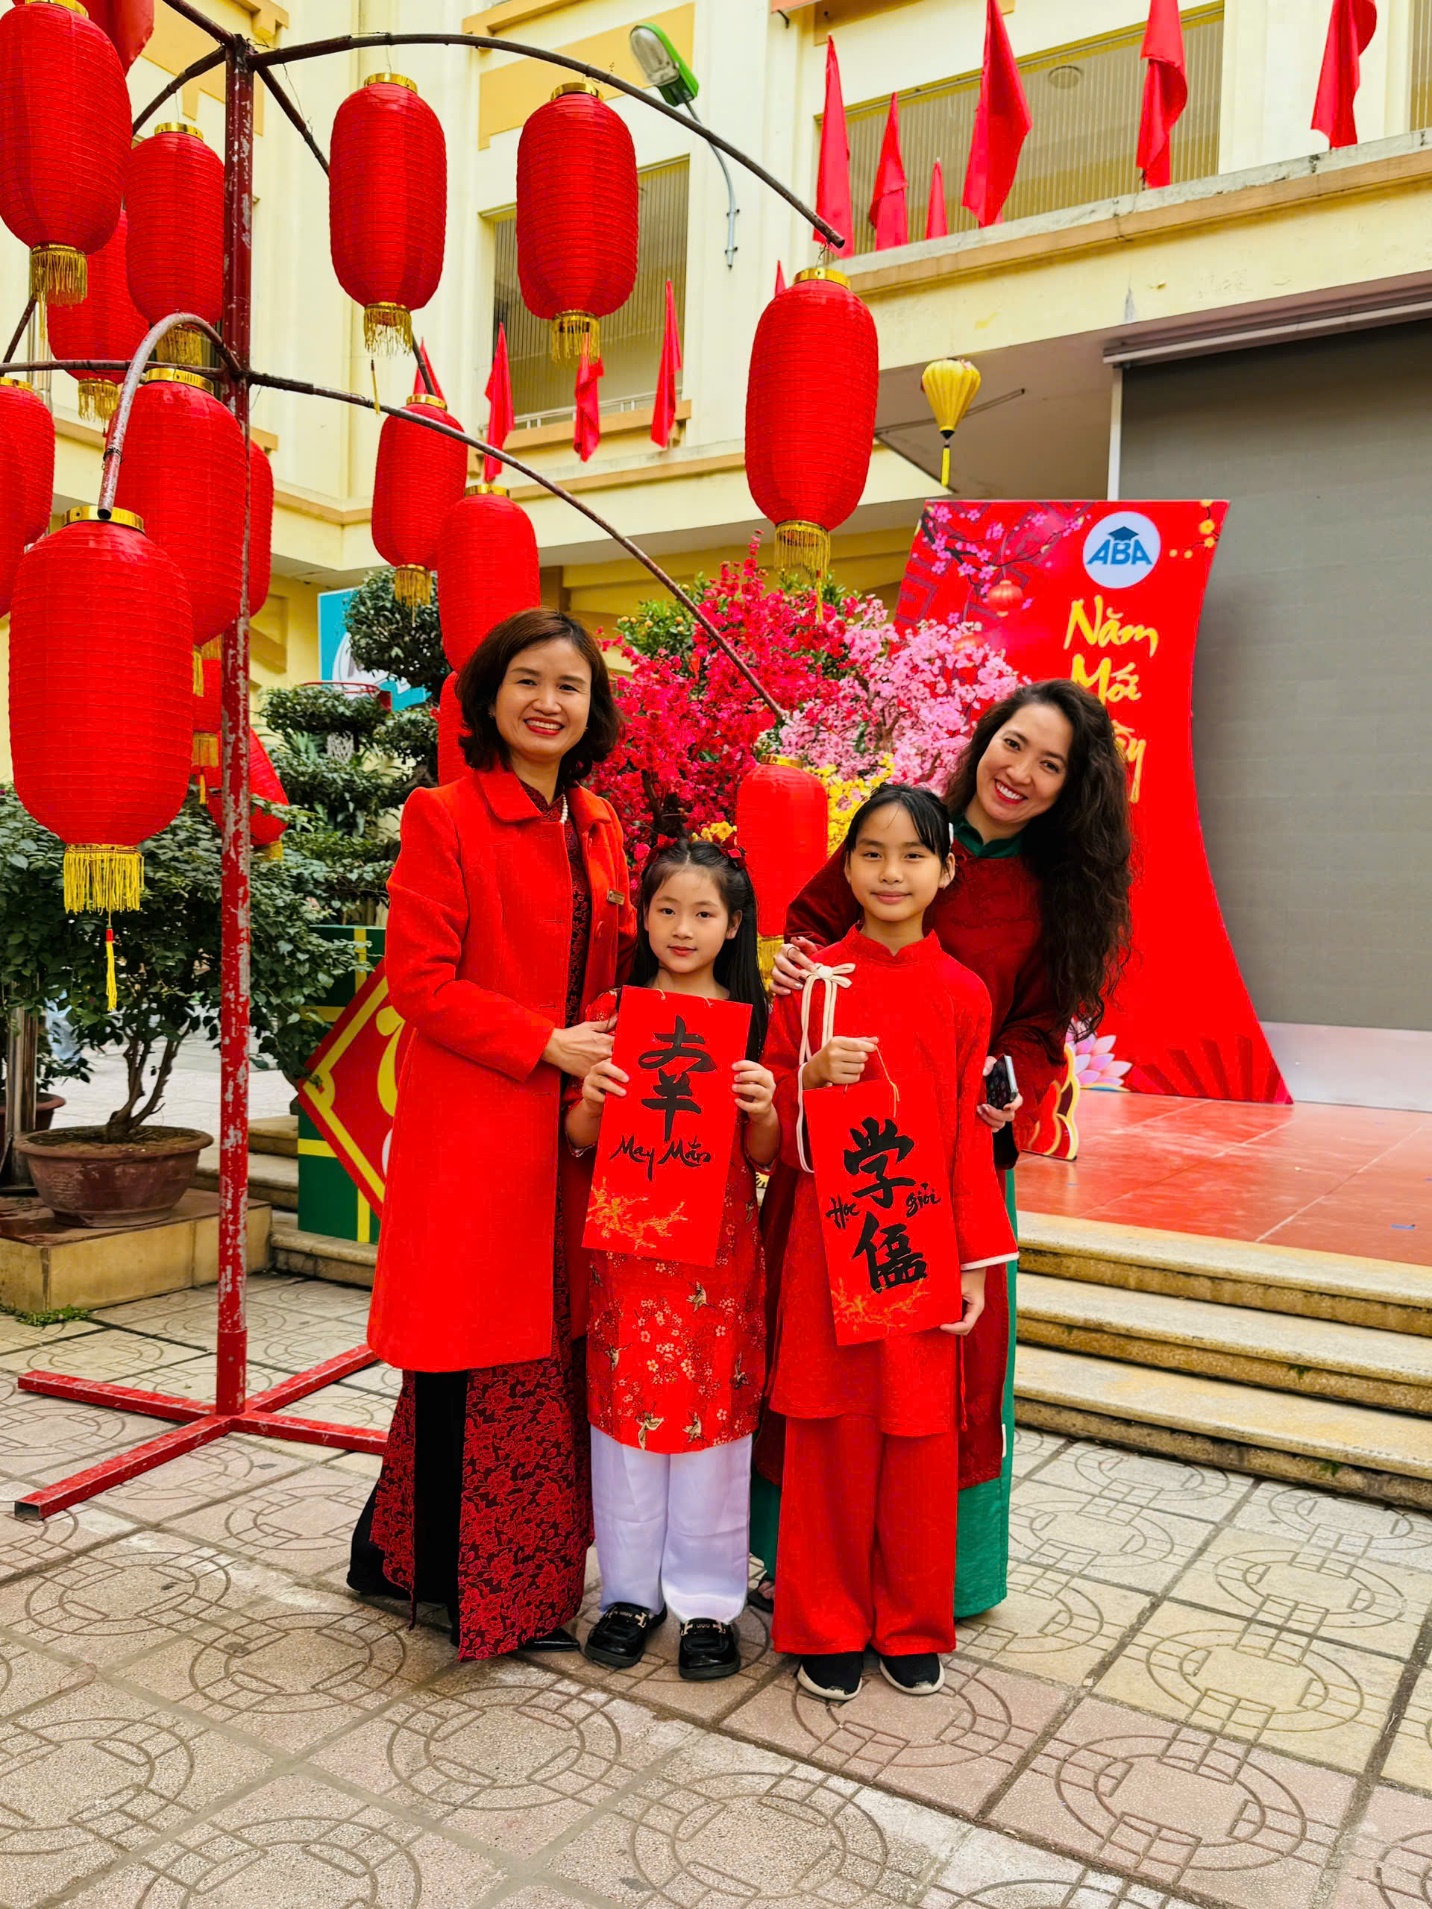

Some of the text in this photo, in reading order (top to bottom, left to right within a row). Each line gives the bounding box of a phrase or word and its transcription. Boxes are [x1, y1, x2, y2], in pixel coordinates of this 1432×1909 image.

[1086, 537, 1153, 565] ABA
[1063, 594, 1159, 657] Năm
[1070, 653, 1142, 706] Mới
[609, 1134, 655, 1181] May
[825, 1195, 860, 1230] Học
